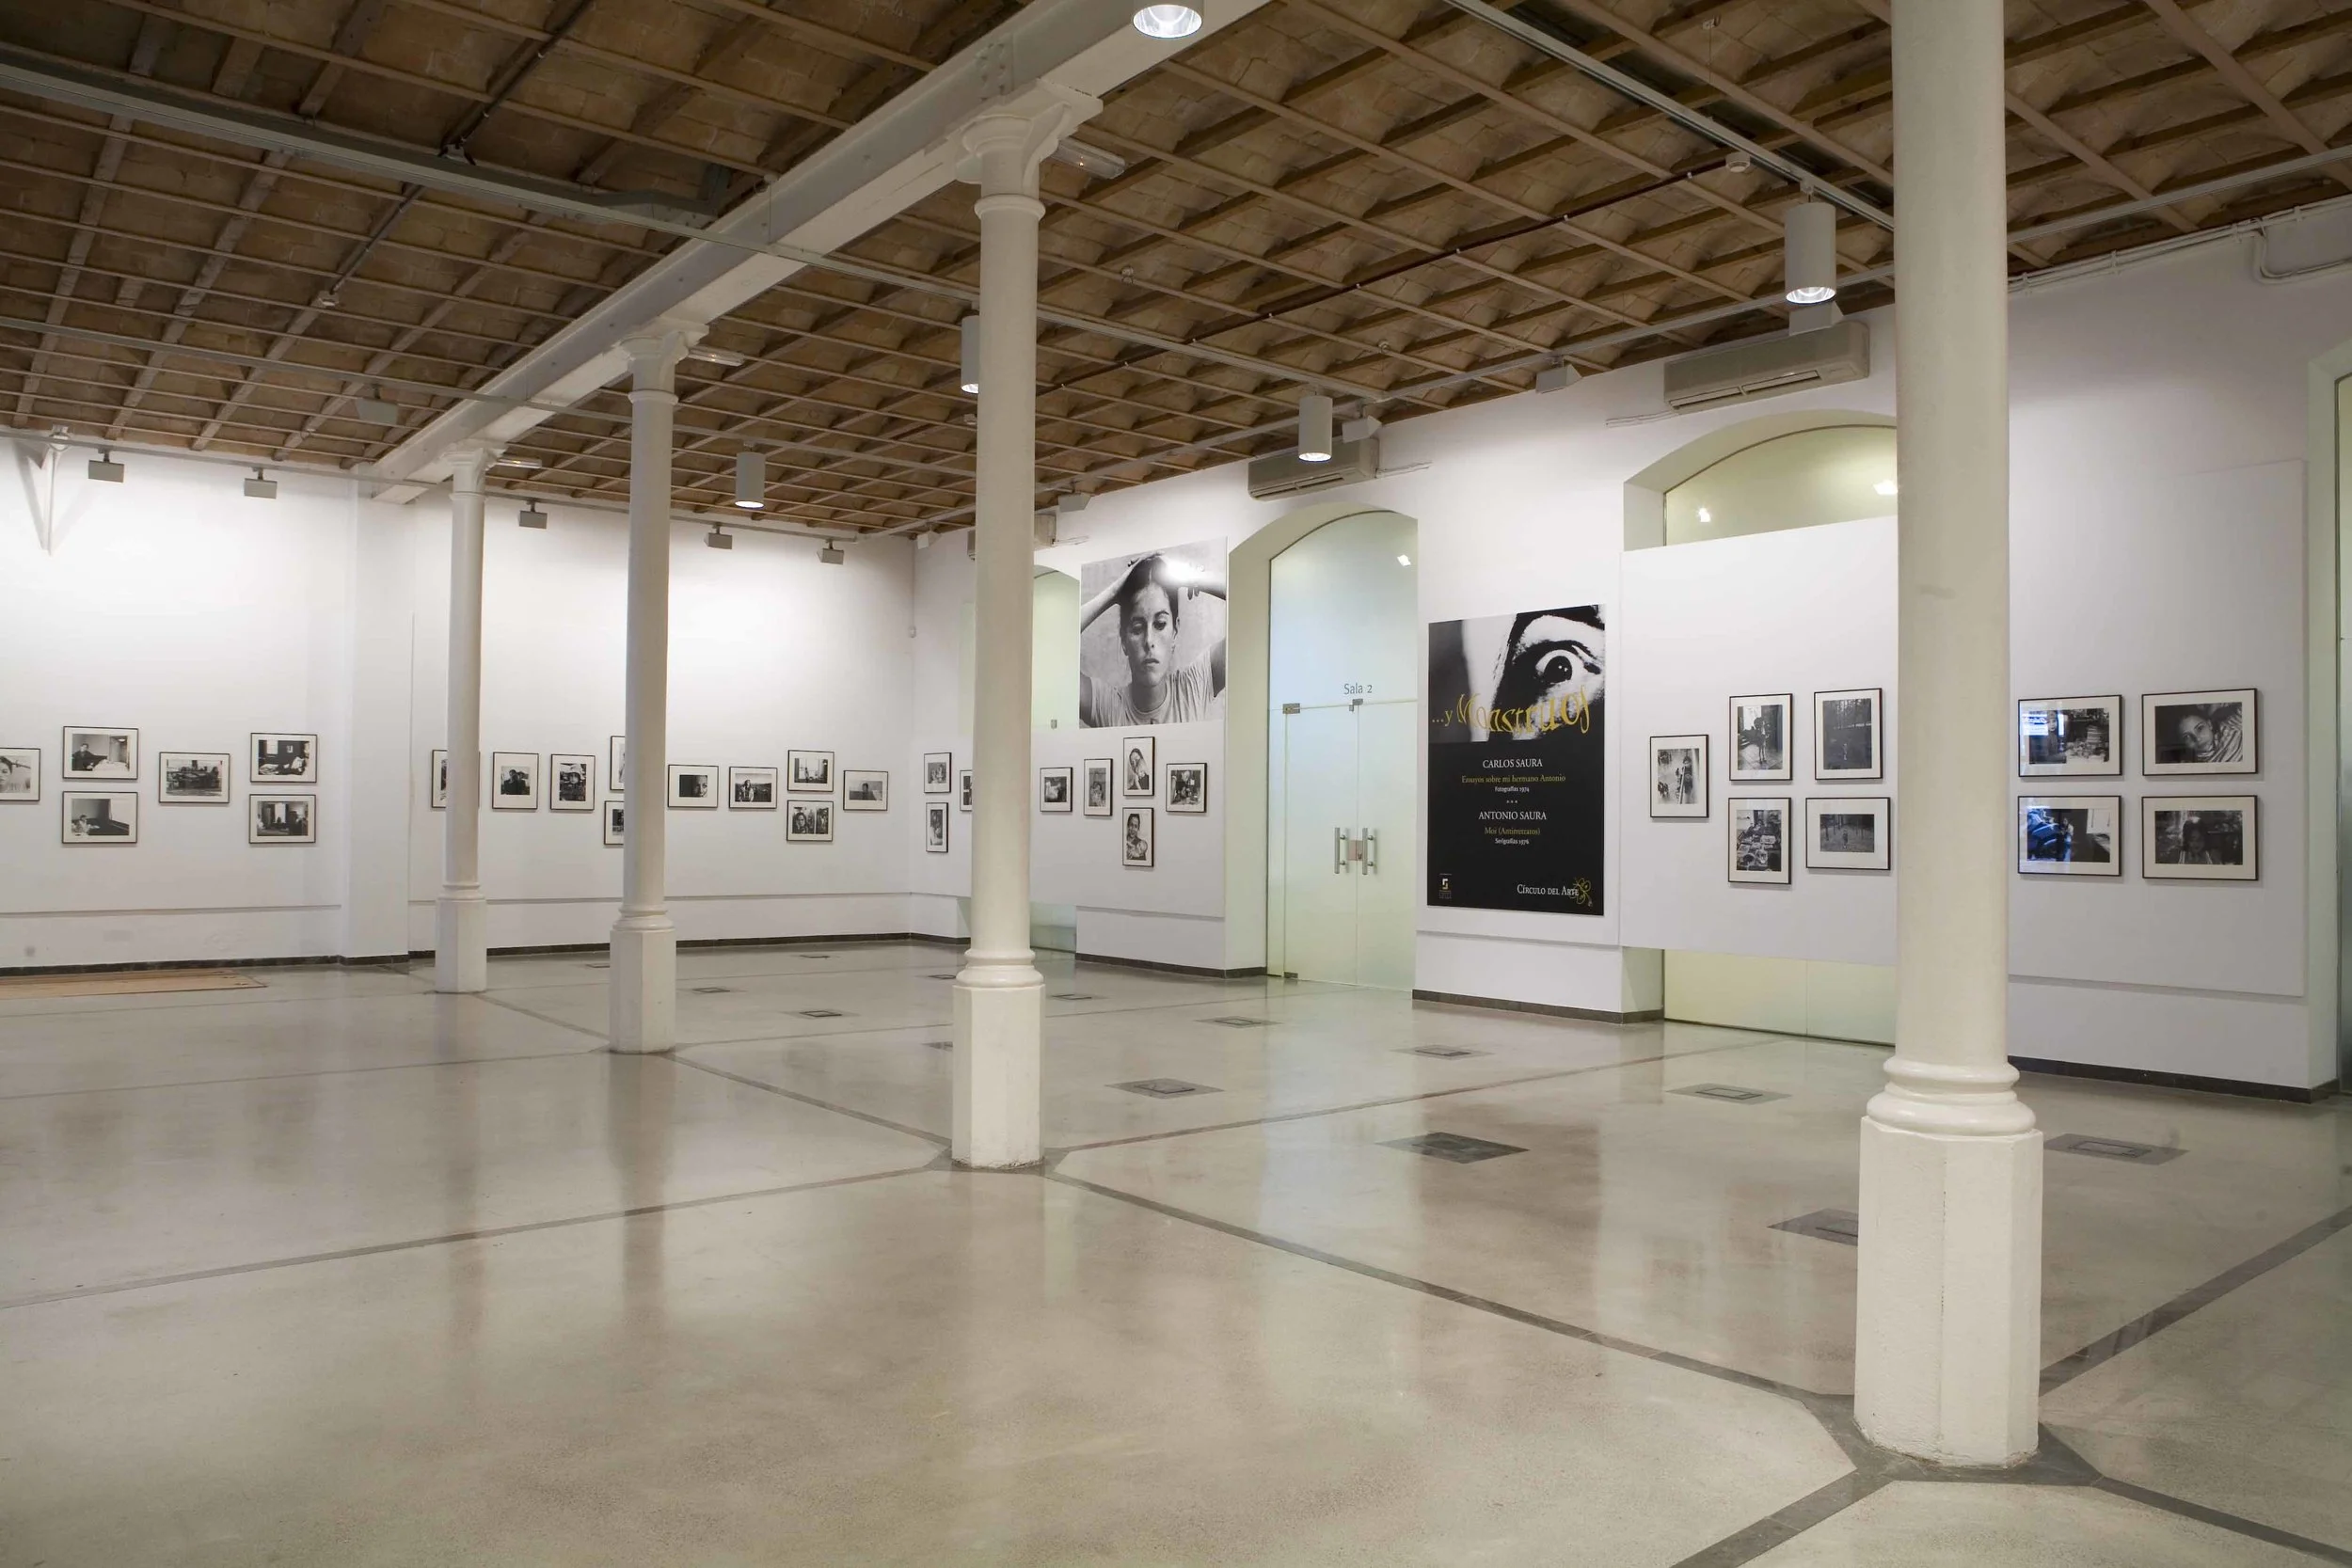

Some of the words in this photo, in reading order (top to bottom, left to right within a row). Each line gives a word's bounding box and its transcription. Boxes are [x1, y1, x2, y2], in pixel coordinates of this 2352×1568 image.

[1343, 682, 1363, 695] Sala
[1366, 684, 1373, 693] 2
[1482, 758, 1515, 768] CARLOS
[1516, 758, 1543, 768] SAURA
[1486, 774, 1502, 784] sobre
[1502, 774, 1511, 783] mi
[1511, 774, 1539, 783] hermano
[1539, 773, 1566, 783] Antonio
[1478, 811, 1518, 820] ANTONIO
[1519, 811, 1547, 820] SAURA
[1547, 887, 1561, 895] DEL
[1561, 885, 1580, 896] ARTE
